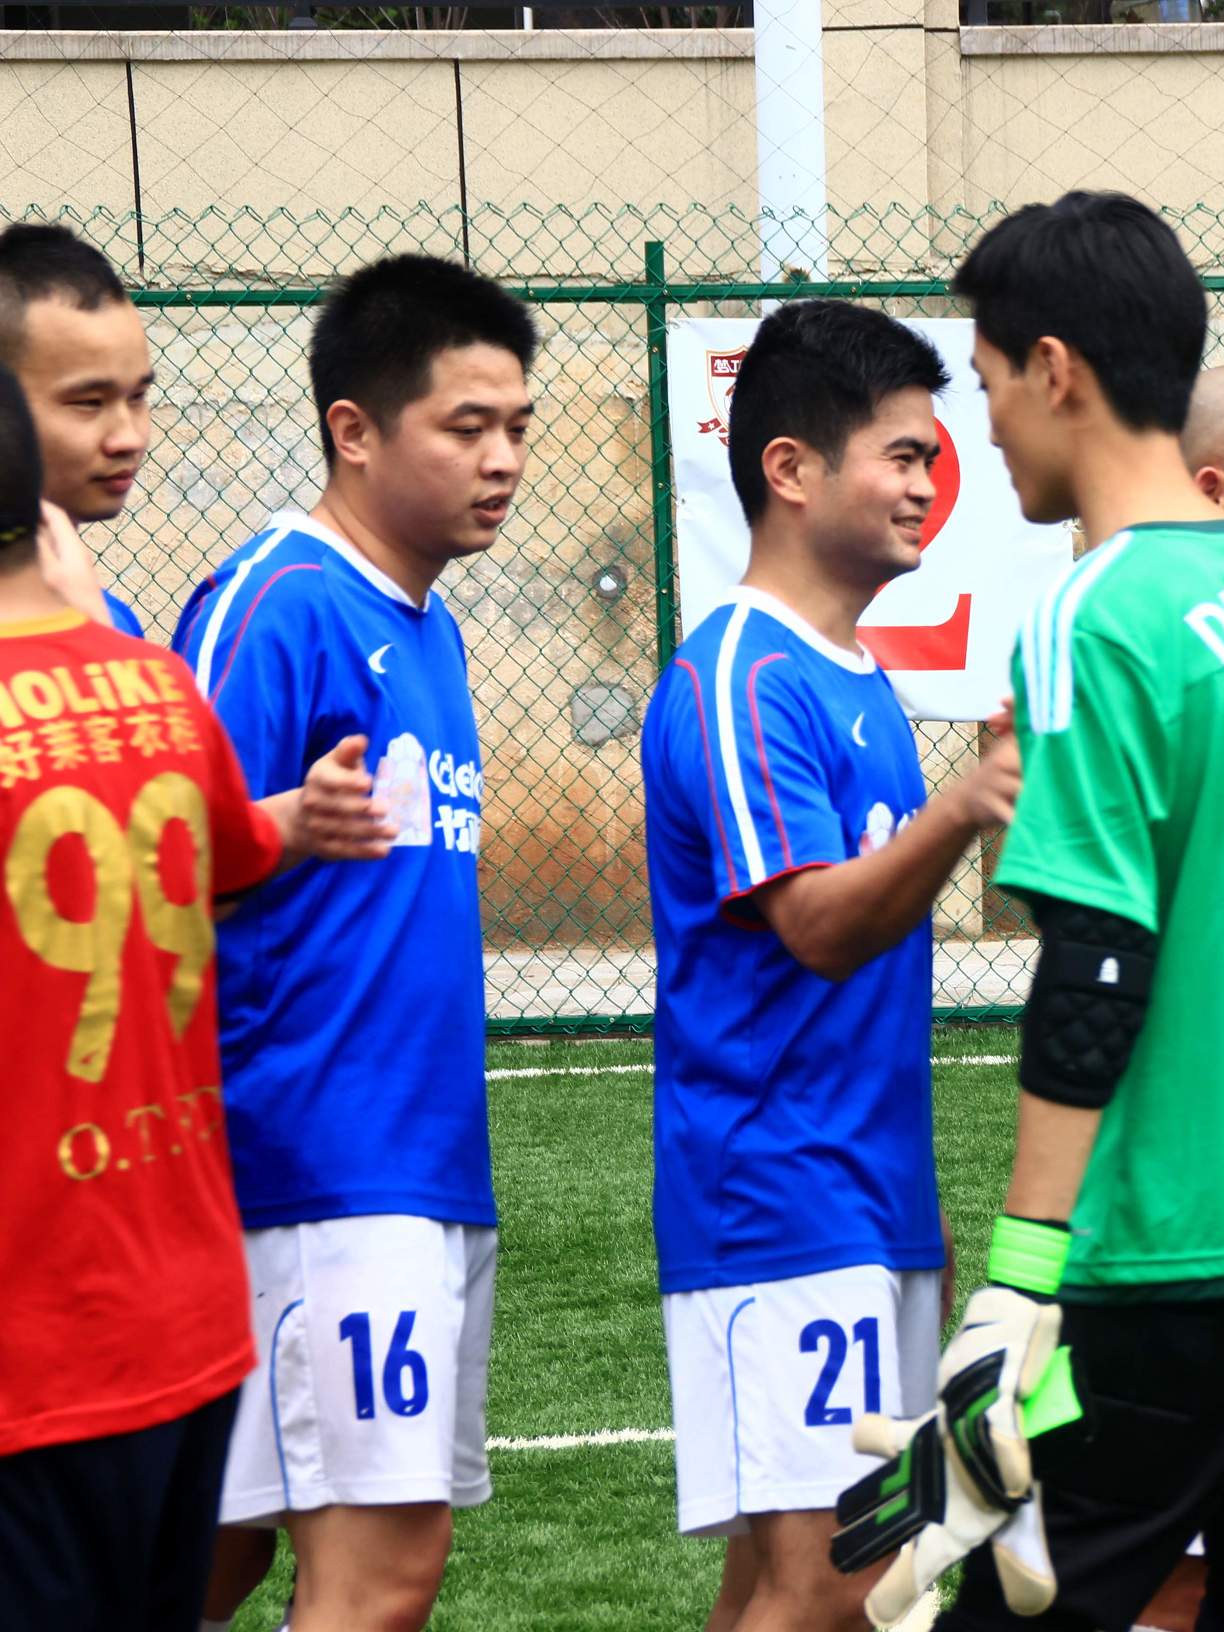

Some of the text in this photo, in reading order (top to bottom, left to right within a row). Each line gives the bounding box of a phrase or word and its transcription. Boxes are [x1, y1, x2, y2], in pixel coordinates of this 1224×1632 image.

[5, 778, 216, 1083] 99
[339, 1311, 429, 1420] 16
[799, 1317, 881, 1427] 21
